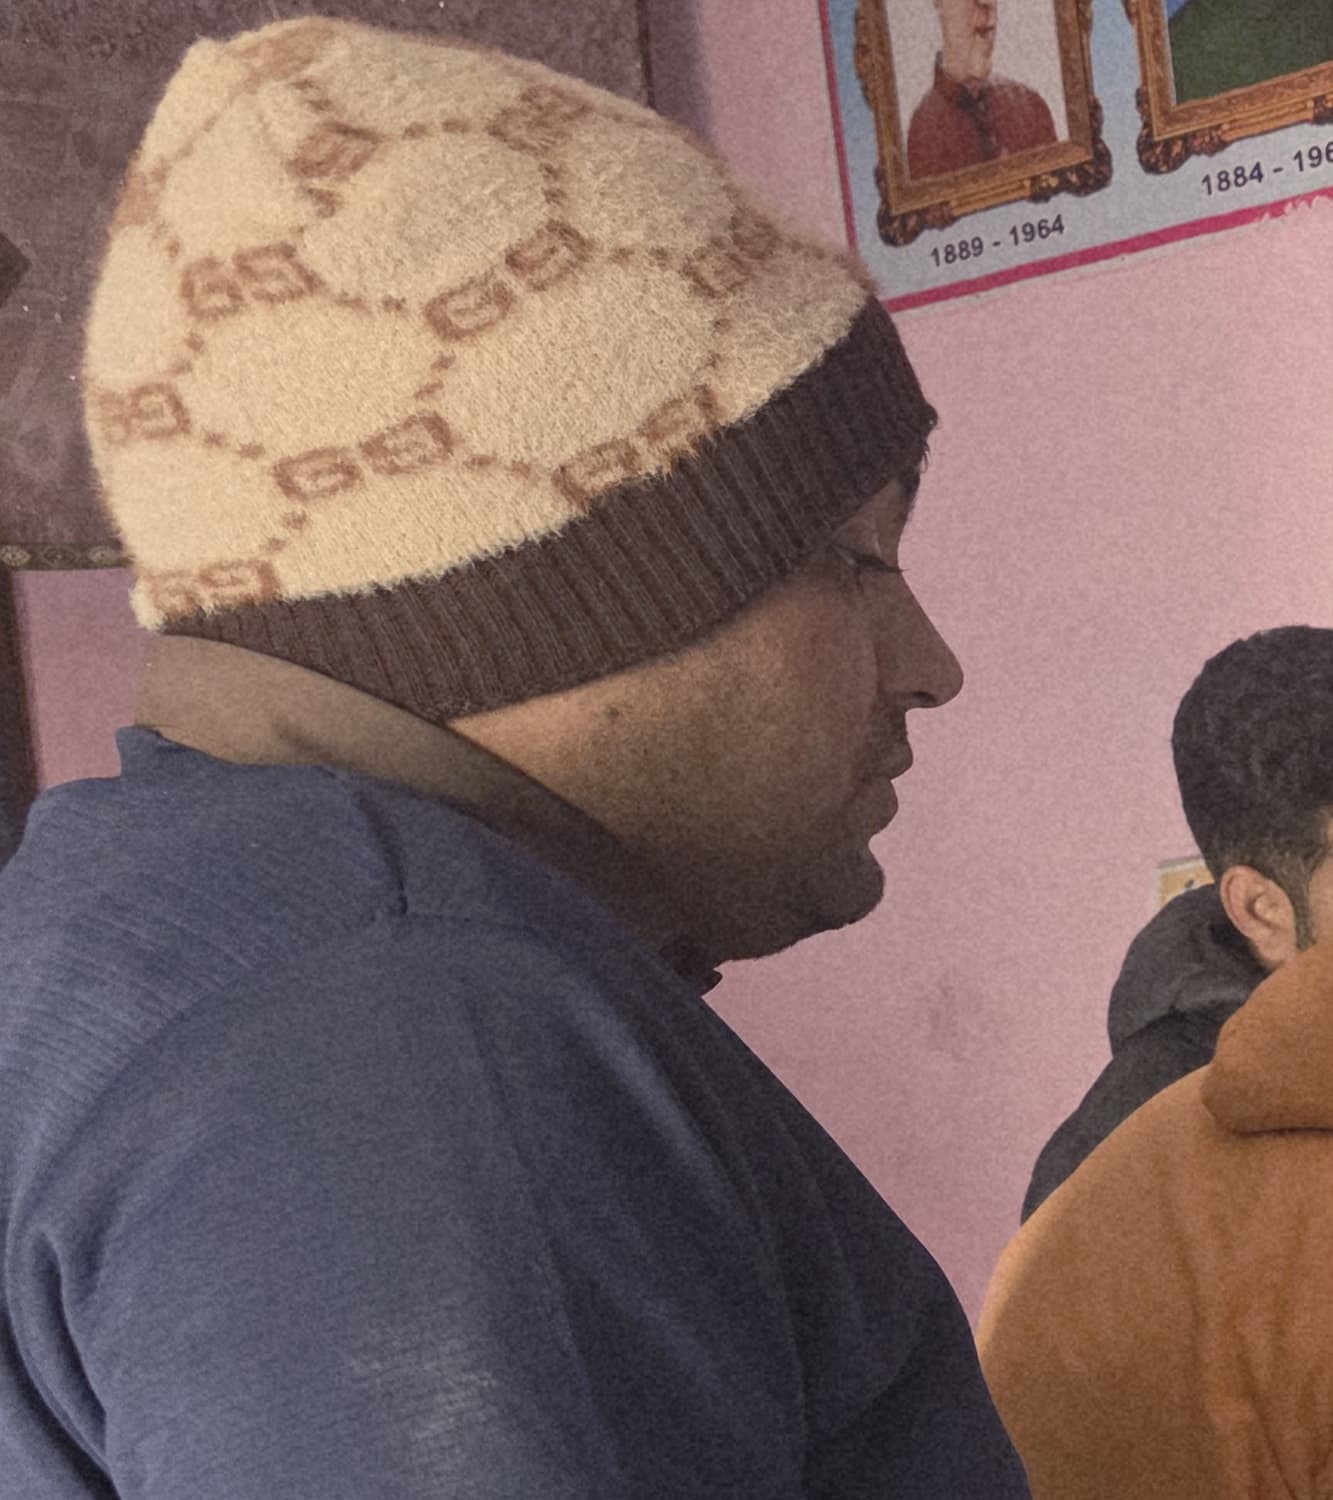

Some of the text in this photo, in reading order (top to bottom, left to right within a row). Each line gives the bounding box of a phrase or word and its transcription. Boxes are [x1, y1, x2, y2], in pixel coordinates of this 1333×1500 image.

[1200, 160, 1266, 196] 1884
[929, 239, 986, 269] 1889
[1008, 213, 1067, 247] 1964
